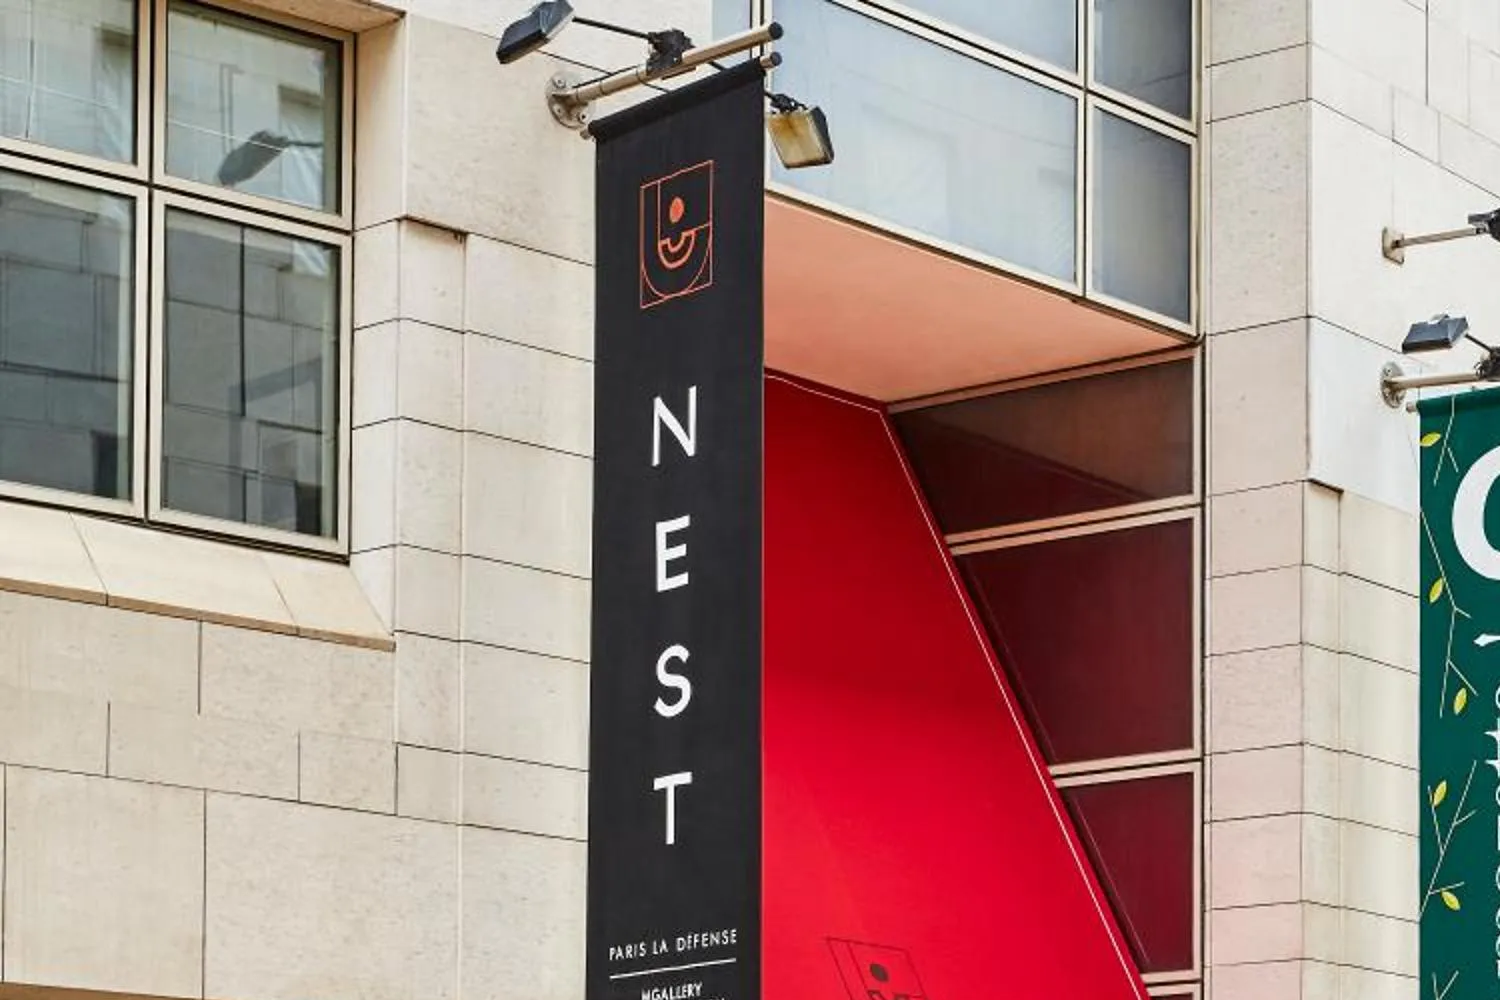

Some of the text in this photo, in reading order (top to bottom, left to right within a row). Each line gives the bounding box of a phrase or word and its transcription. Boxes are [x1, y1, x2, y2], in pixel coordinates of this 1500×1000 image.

[652, 385, 697, 845] NEST
[609, 928, 737, 961] PARIS LA DÉFENSE
